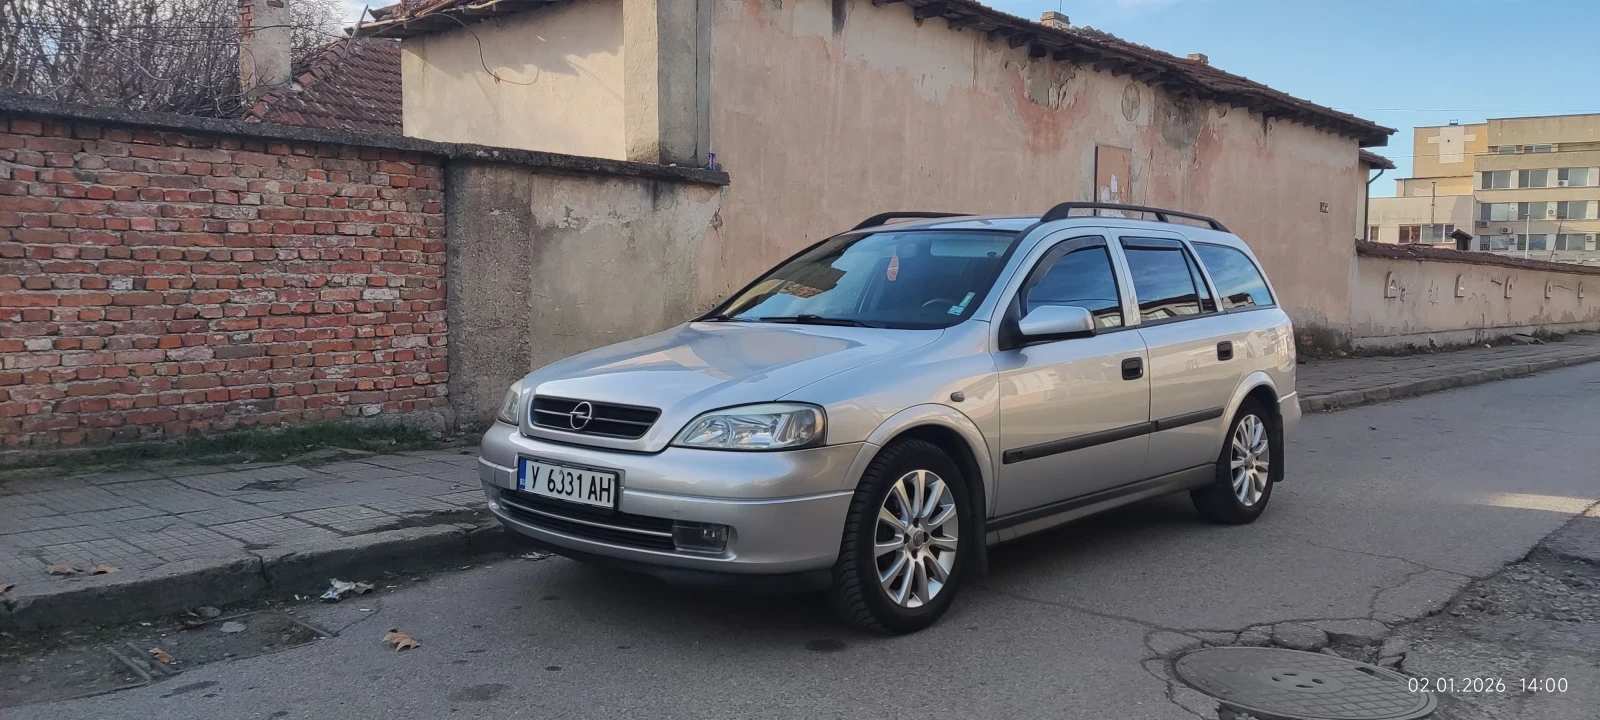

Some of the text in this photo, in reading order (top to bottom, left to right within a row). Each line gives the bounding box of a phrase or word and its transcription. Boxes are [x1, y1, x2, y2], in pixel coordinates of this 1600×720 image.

[531, 465, 612, 503] Y 6331 AH
